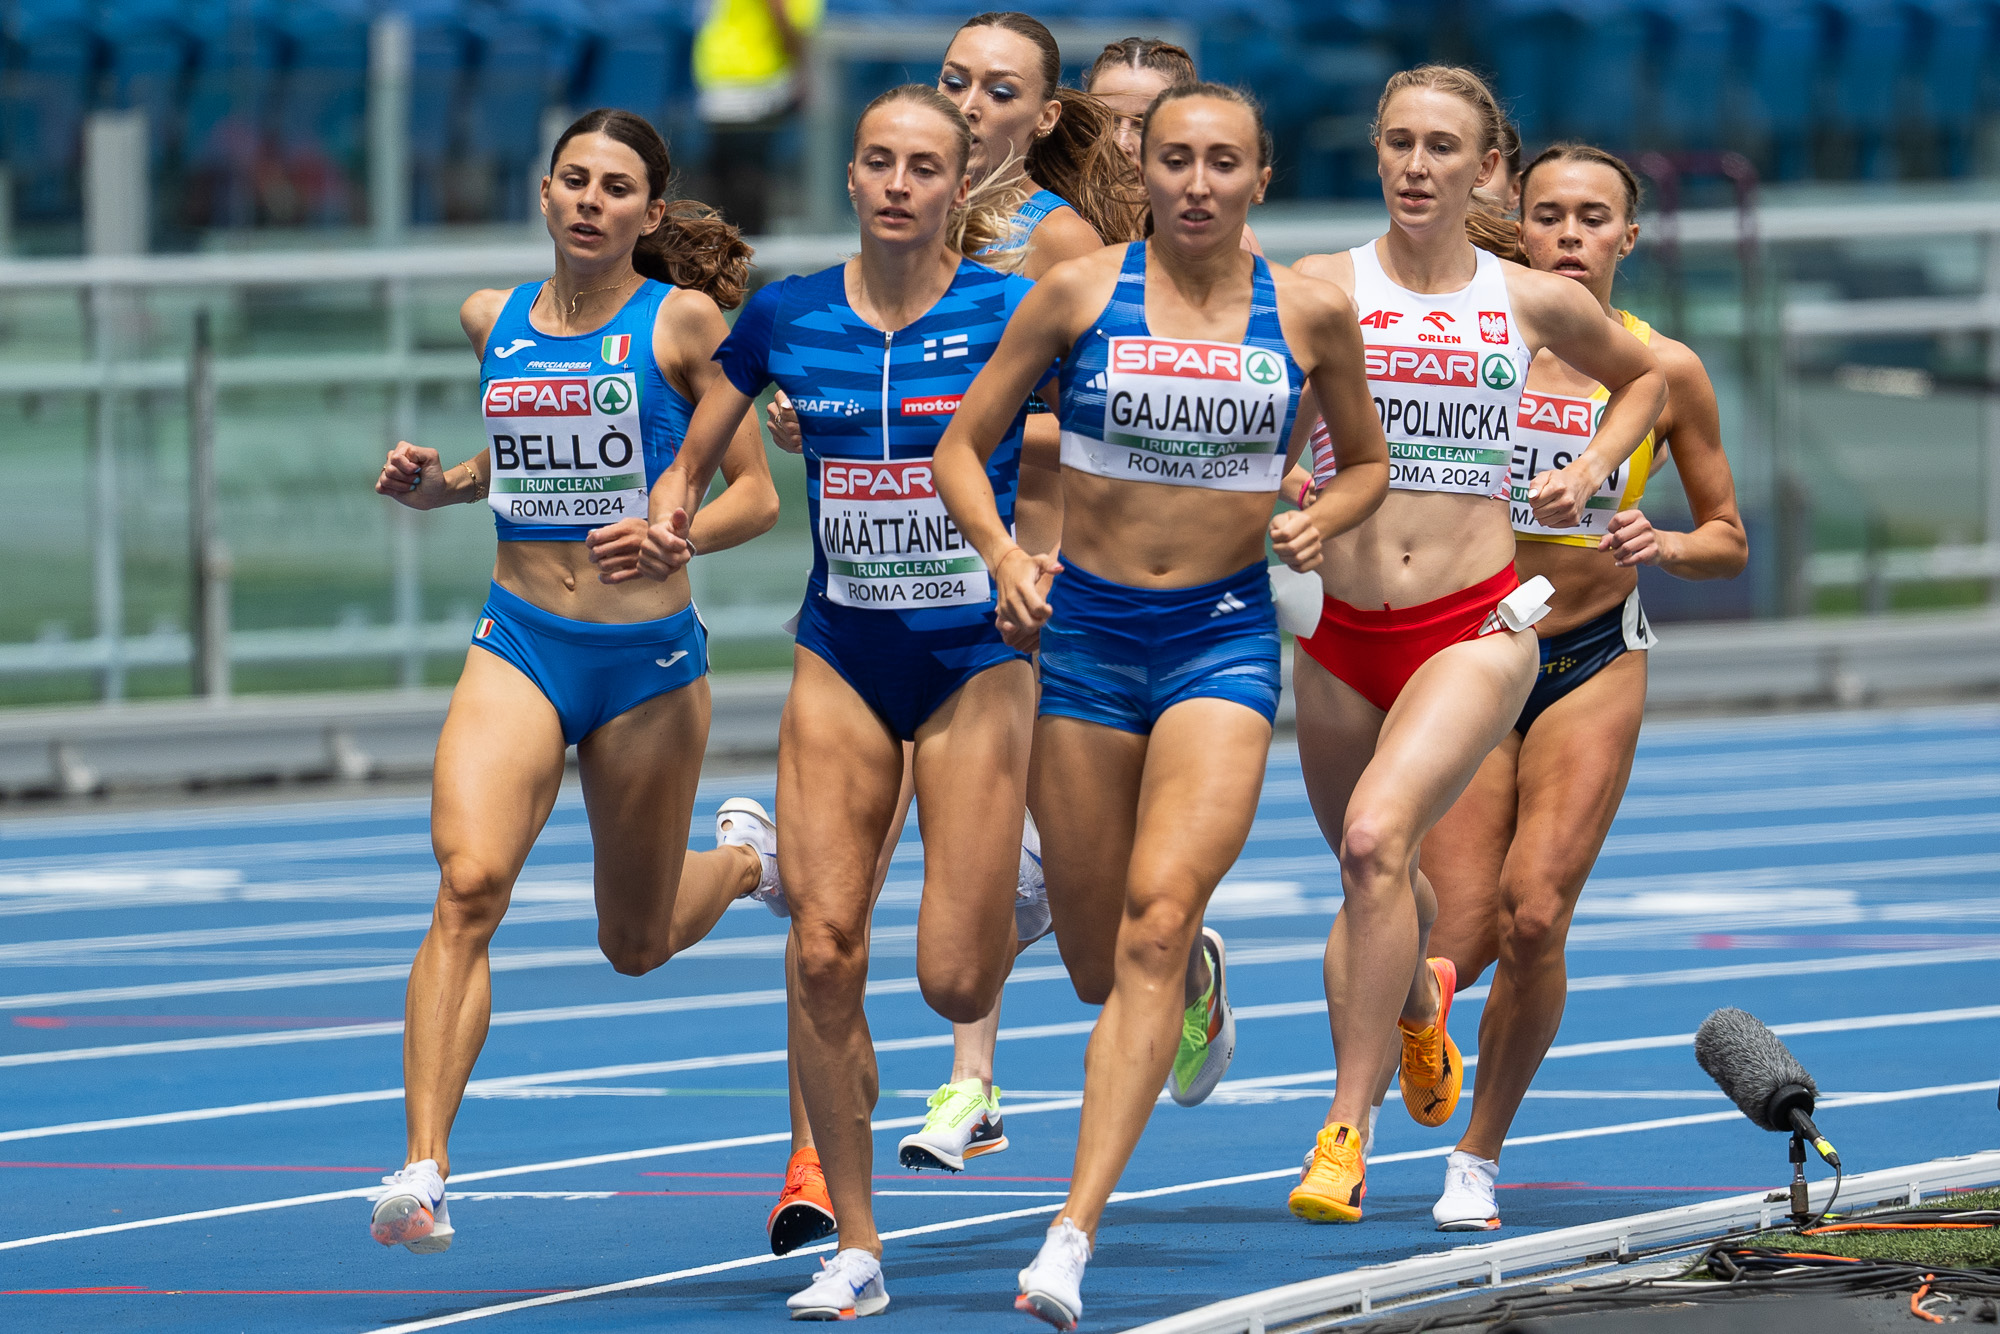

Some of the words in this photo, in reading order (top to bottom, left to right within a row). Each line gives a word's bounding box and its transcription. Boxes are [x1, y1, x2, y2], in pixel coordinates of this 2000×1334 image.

[1418, 333, 1461, 344] ORLEN
[527, 361, 592, 369] FRECCIAROSSA
[1116, 343, 1239, 377] SPAR
[1364, 349, 1475, 382] SPAR
[488, 384, 588, 412] SPAR
[1111, 390, 1276, 436] GAJANOVÁ
[1519, 397, 1588, 432] PAR
[493, 424, 633, 470] BELLÒ
[1141, 438, 1146, 448] I
[1149, 440, 1184, 455] RUN
[1389, 444, 1423, 458] RUN
[1127, 452, 1196, 479] ROMA
[1201, 458, 1250, 479] 2024
[1389, 464, 1436, 484] OMA
[1441, 468, 1491, 488] 2024
[520, 479, 525, 492] I
[526, 479, 555, 492] RUN
[826, 466, 933, 495] SPAR
[510, 500, 570, 517] ROMA
[573, 497, 625, 516] 2024
[824, 510, 966, 554] MÄÄTTÄNE
[852, 564, 857, 576] I
[857, 563, 890, 577] RUN
[848, 582, 907, 602] ROMA
[911, 580, 966, 600] 2024
